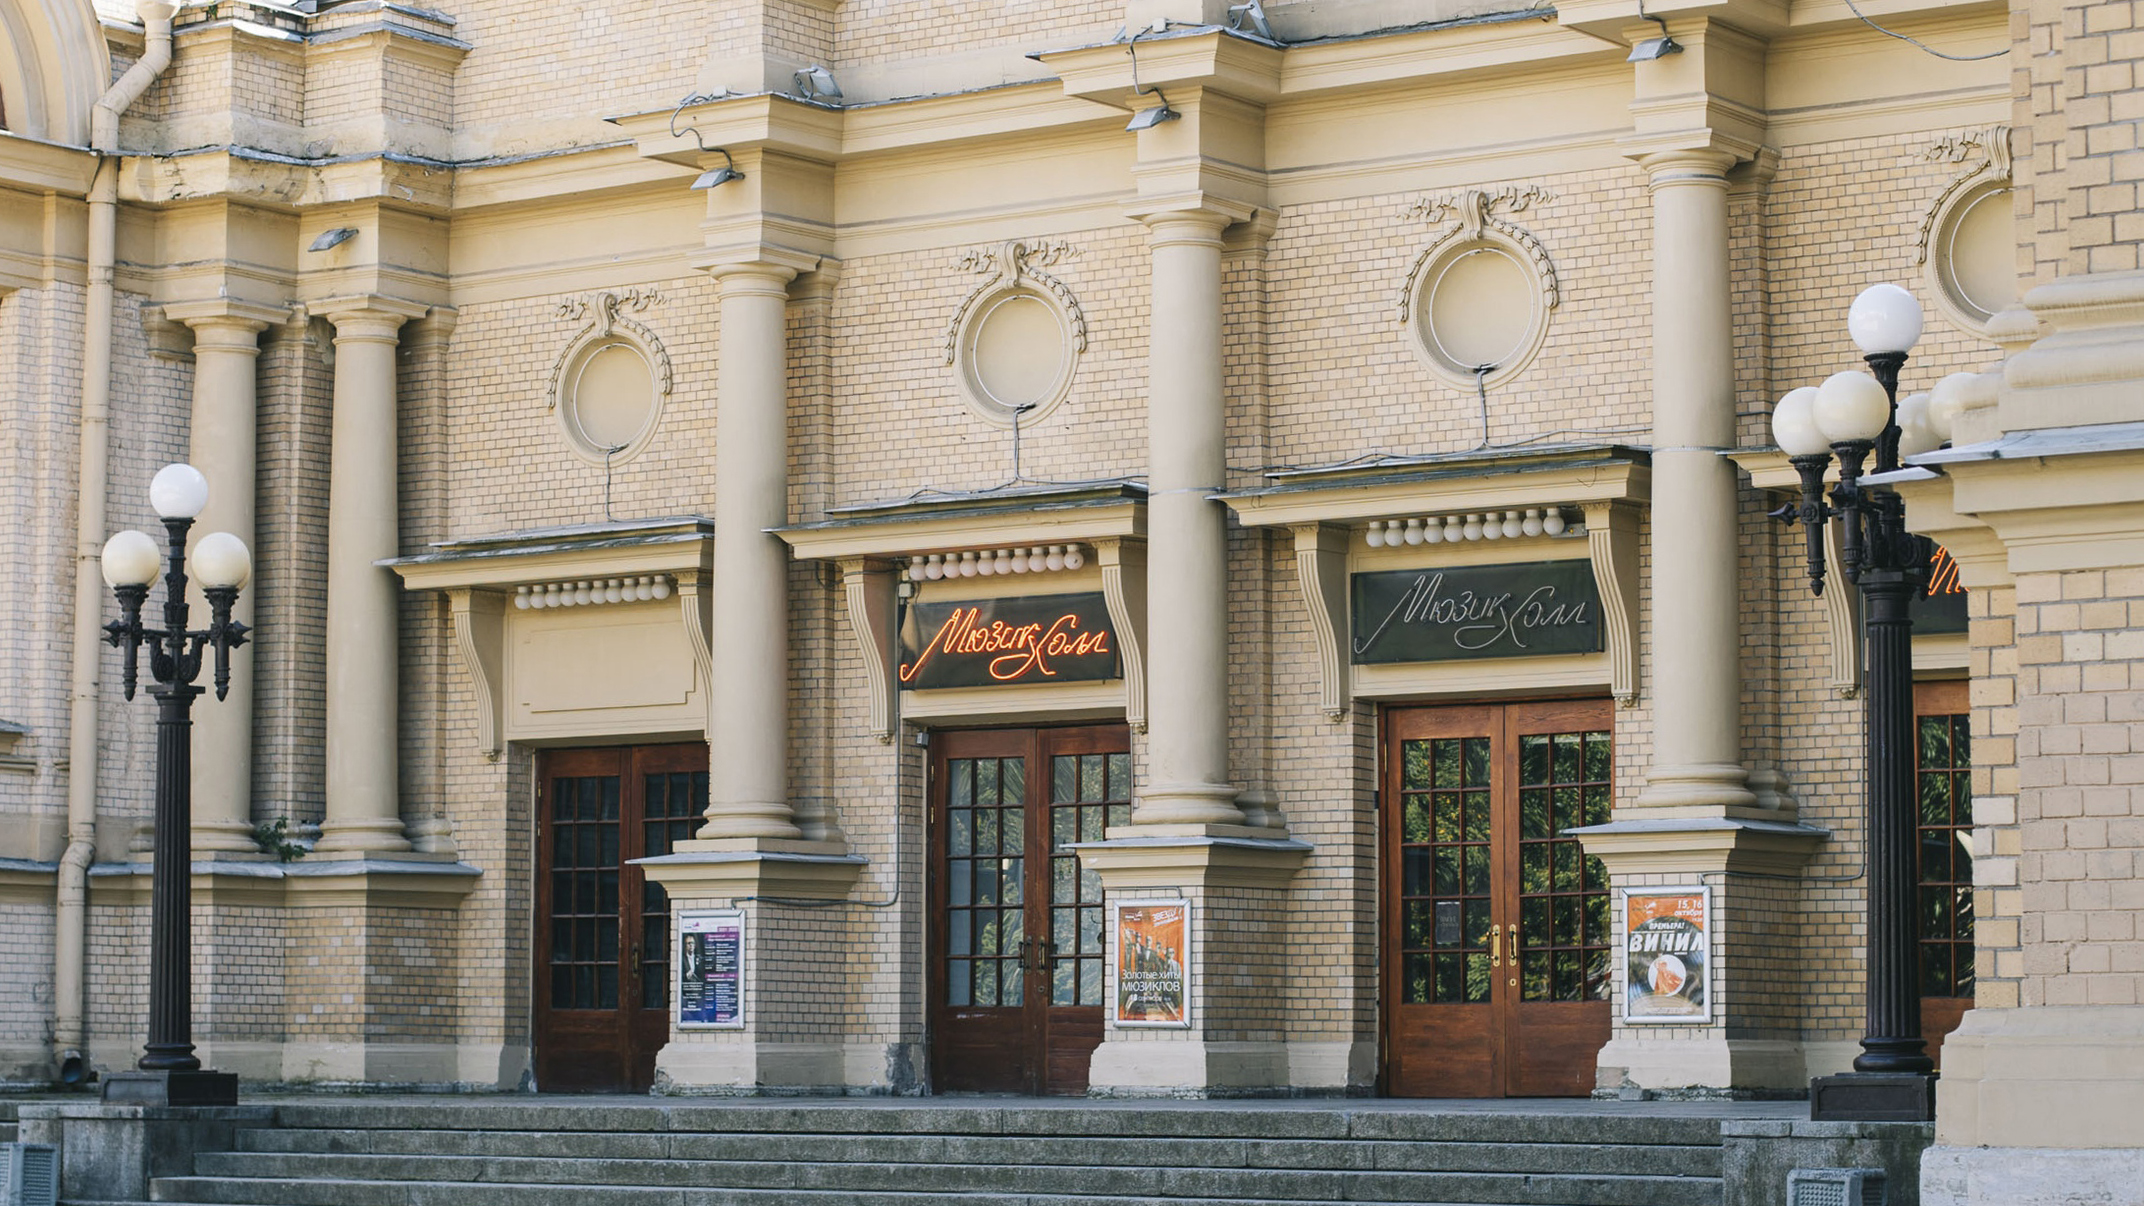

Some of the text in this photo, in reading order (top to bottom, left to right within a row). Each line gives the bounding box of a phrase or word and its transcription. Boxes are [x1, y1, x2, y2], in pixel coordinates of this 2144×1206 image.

[1693, 900, 1702, 908] 16
[1629, 932, 1703, 952] ВИНИЛ
[1122, 969, 1181, 980] Золотые хиты
[1122, 981, 1180, 992] МЮЗИКЛОВ
